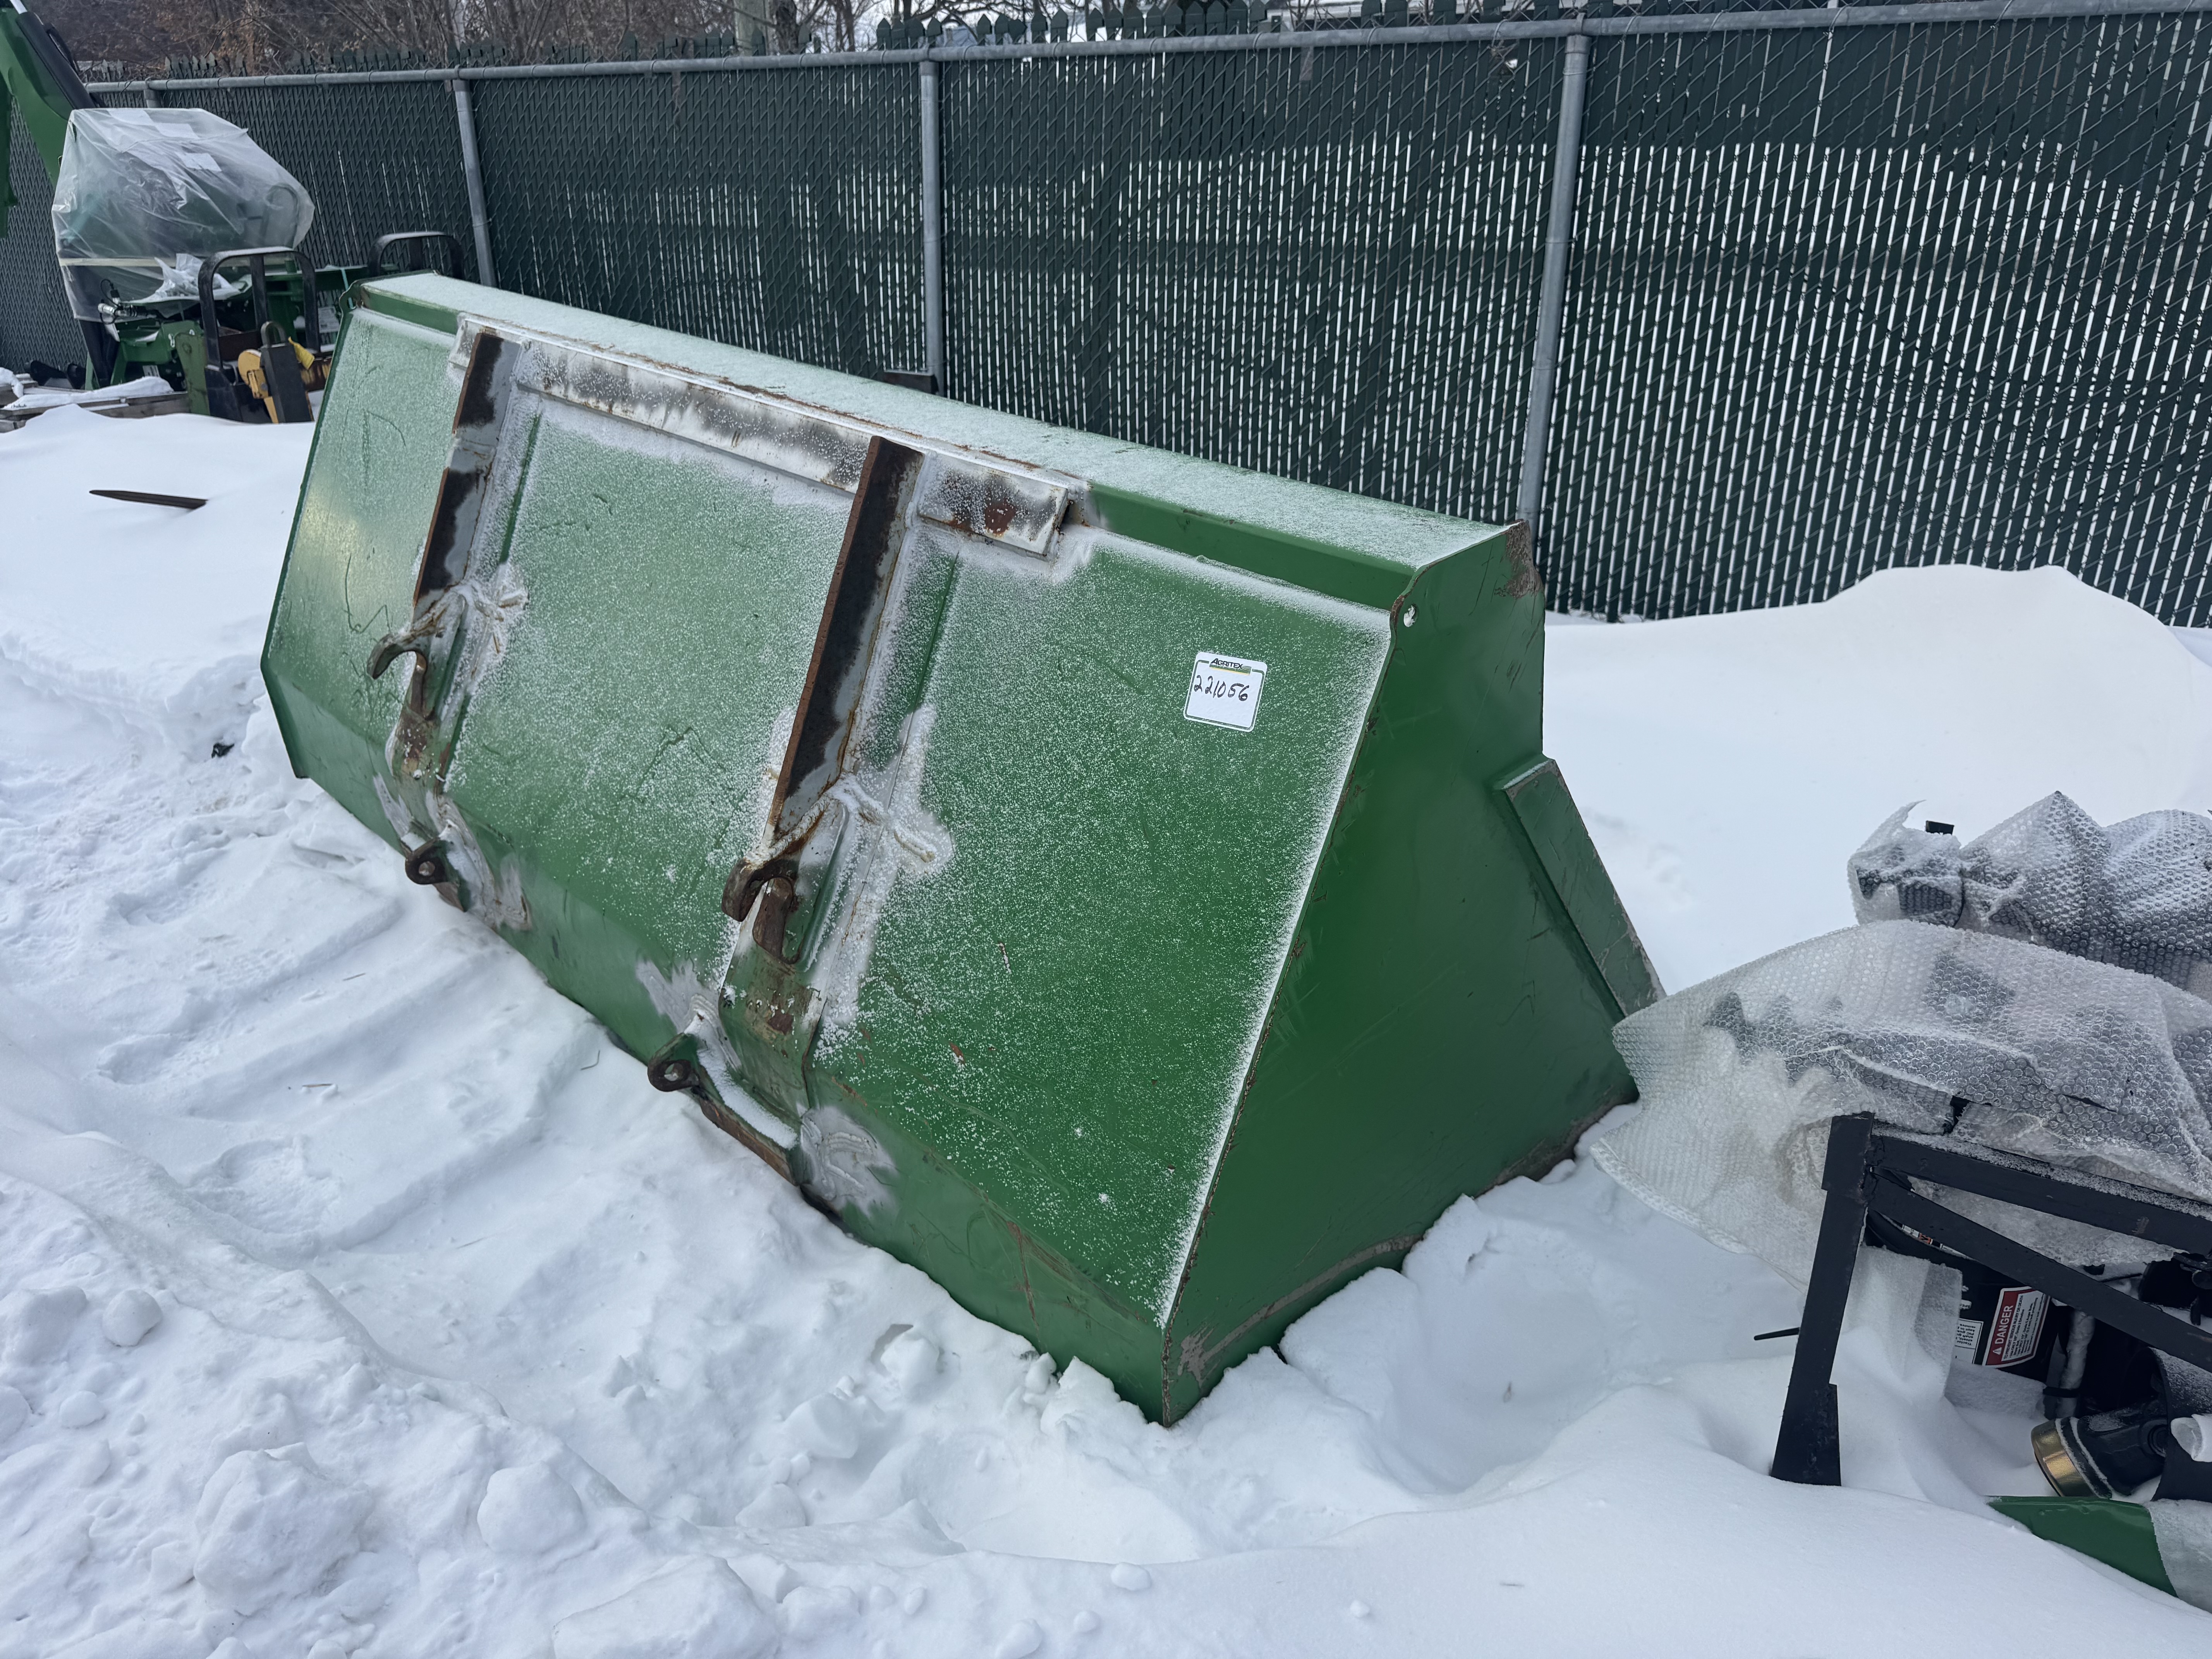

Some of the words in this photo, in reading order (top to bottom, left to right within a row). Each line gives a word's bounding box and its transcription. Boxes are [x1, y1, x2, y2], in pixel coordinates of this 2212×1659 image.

[1211, 658, 1243, 669] AGRITEX
[1194, 675, 1250, 701] 221056
[1995, 1305, 2013, 1344] DANGER
